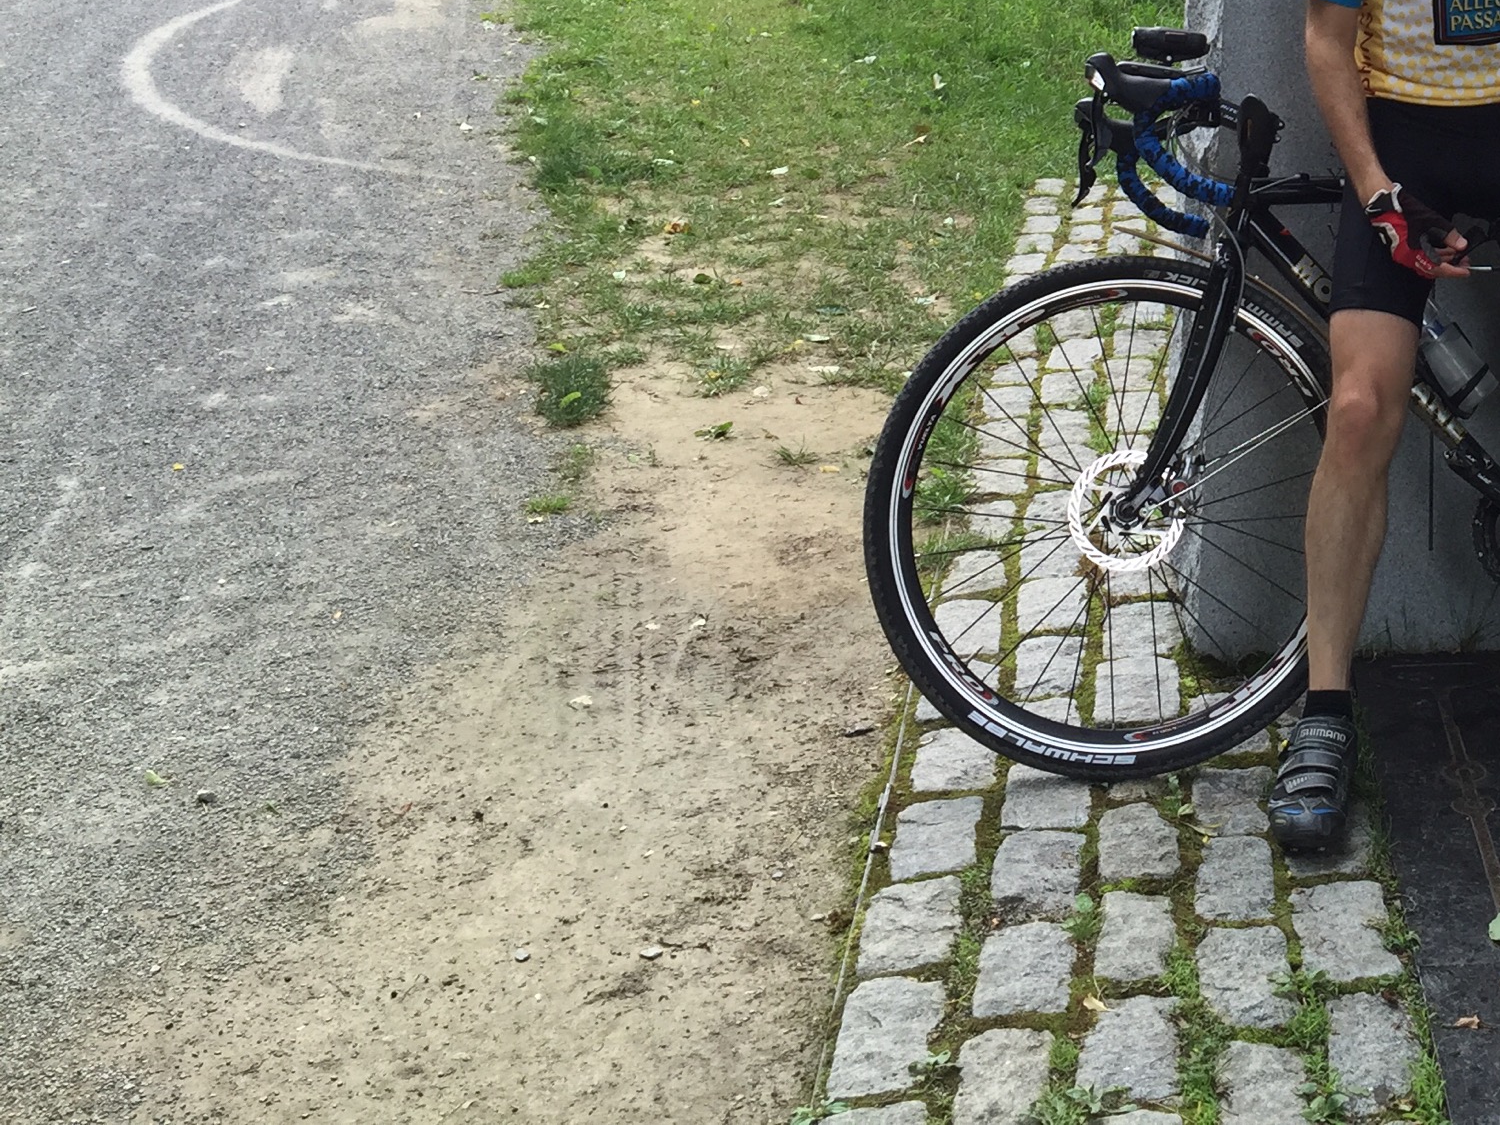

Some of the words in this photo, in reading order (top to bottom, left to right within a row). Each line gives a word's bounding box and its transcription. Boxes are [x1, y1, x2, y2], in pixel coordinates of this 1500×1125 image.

[917, 413, 938, 451] VUELTA
[929, 631, 985, 693] PRO
[967, 710, 1137, 766] SCHWALBE
[1299, 728, 1347, 743] SHIMANO
